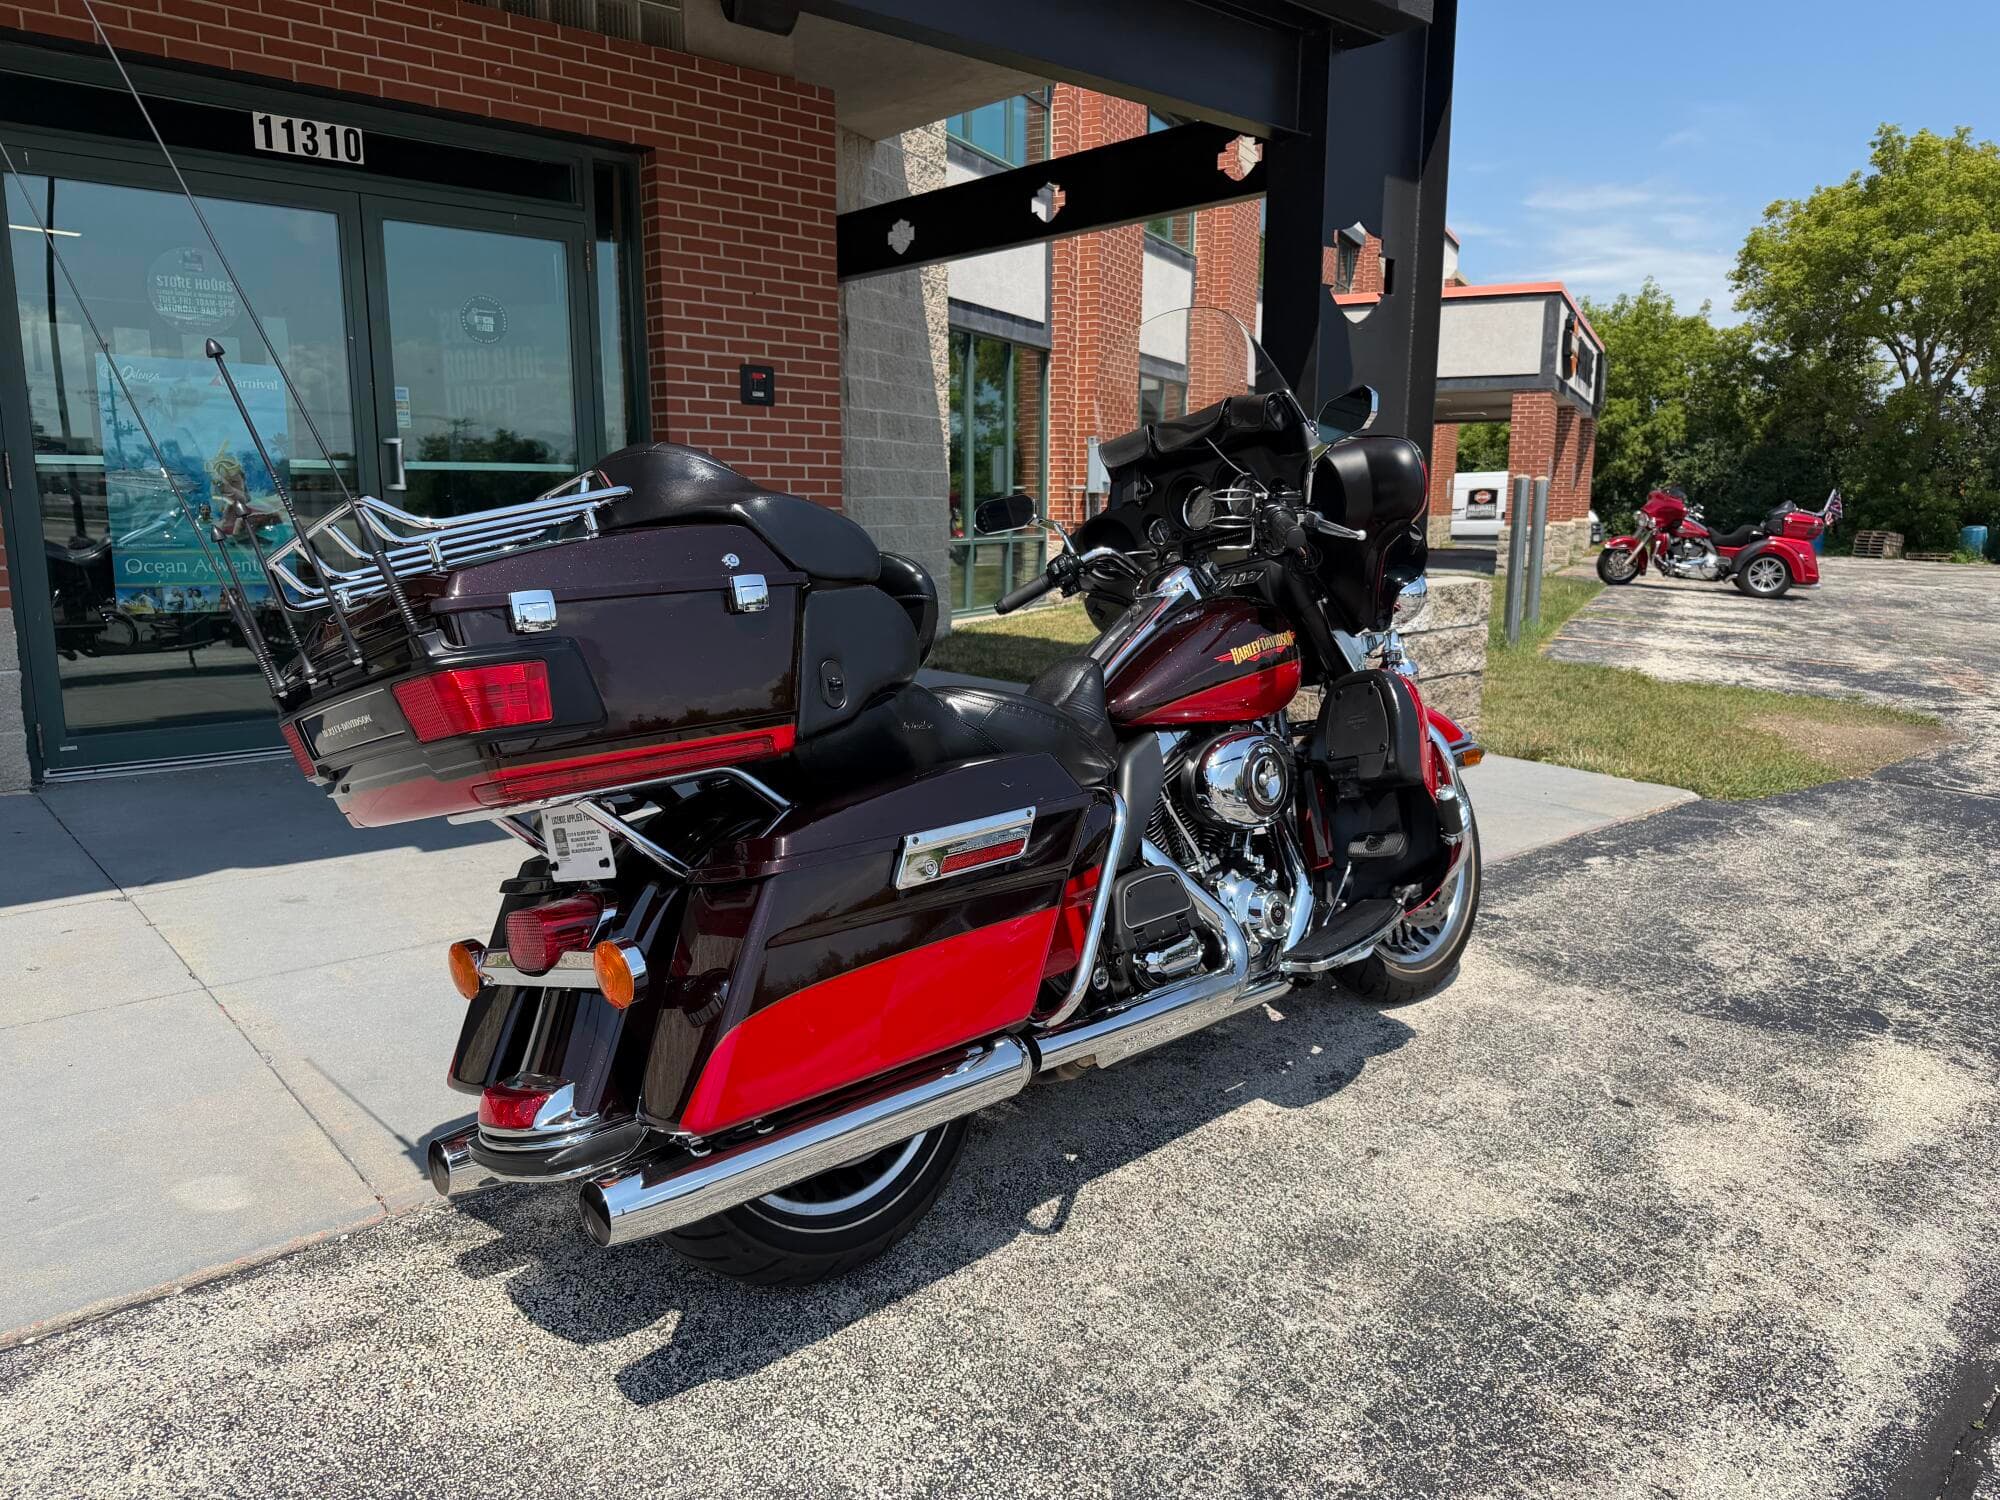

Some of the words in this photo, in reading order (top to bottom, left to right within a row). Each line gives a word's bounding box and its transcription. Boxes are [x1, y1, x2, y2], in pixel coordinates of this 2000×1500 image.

[258, 114, 361, 162] 11310
[156, 275, 191, 289] STORE
[195, 278, 234, 293] HOURS
[230, 379, 279, 391] arnival
[125, 558, 187, 574] Ocean
[567, 813, 583, 824] APPLIED
